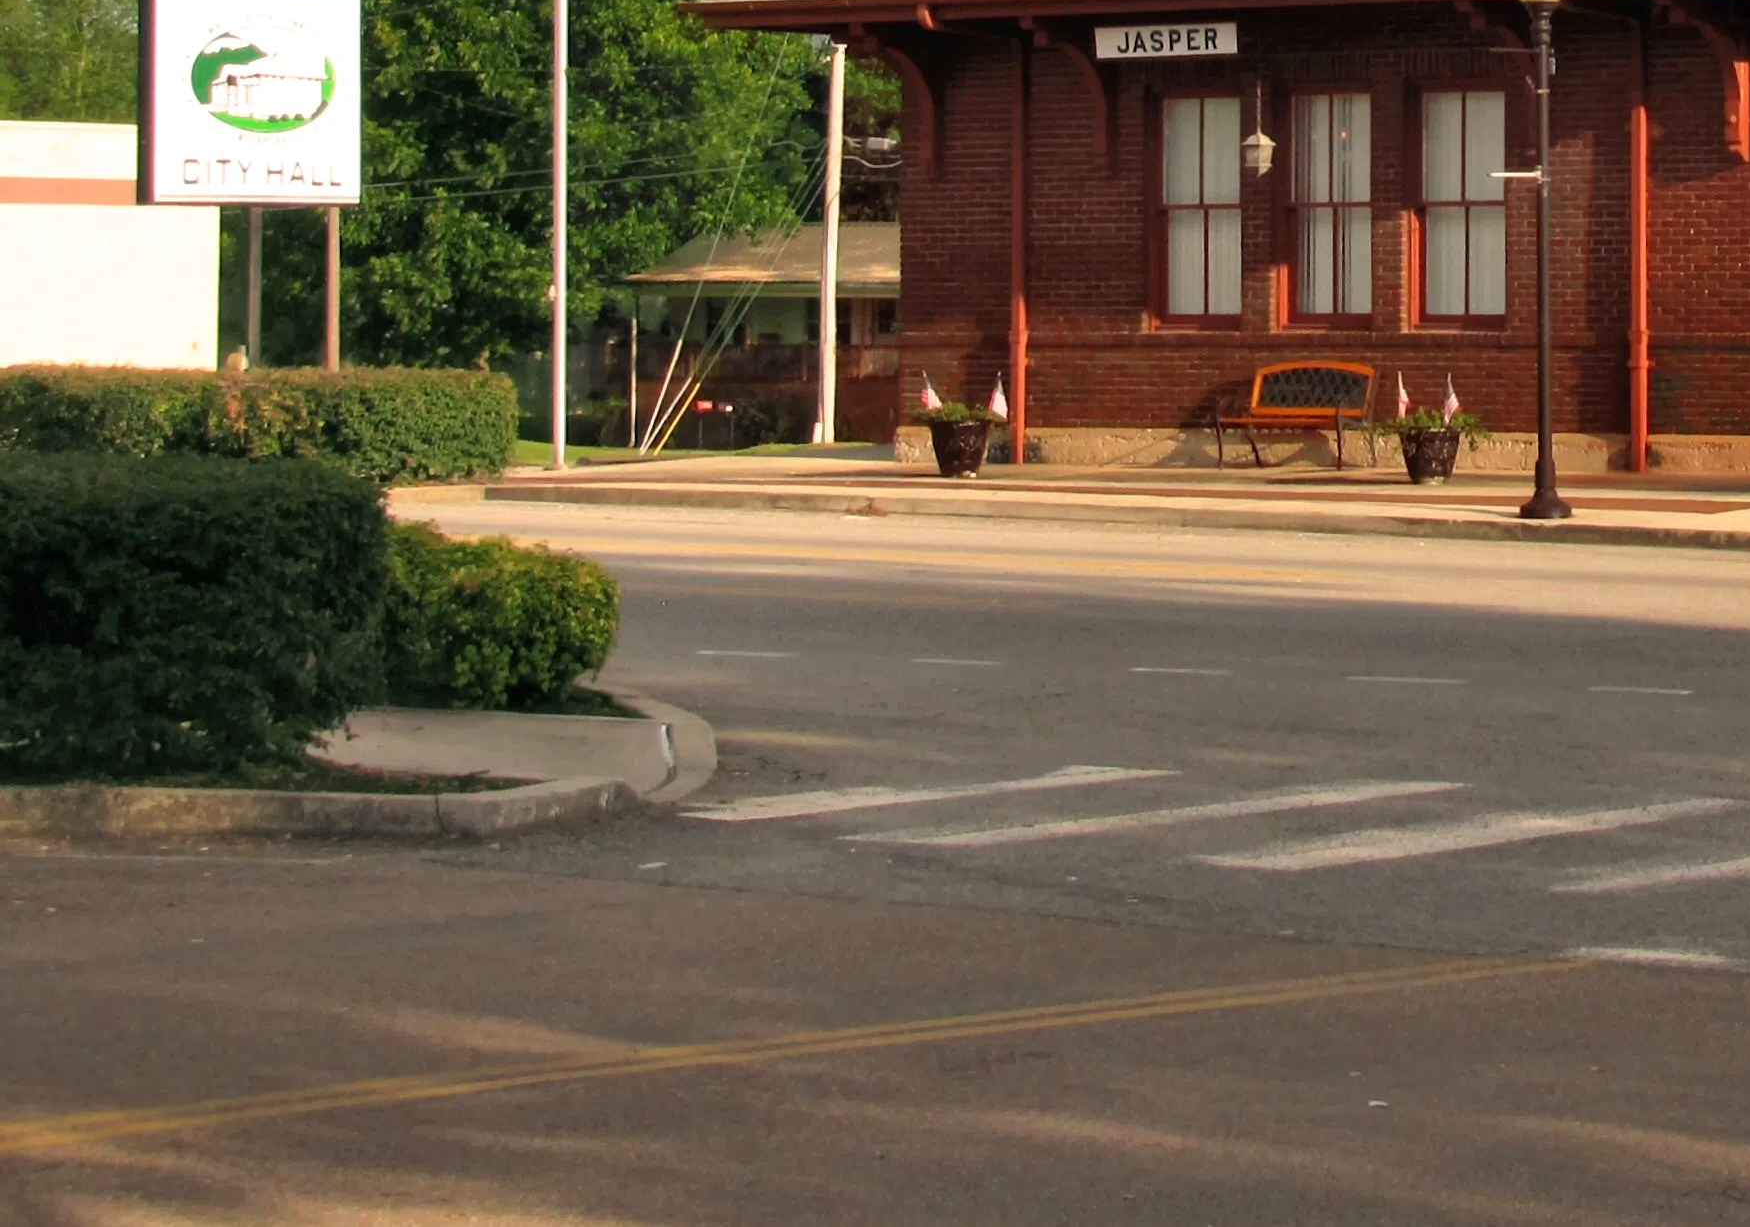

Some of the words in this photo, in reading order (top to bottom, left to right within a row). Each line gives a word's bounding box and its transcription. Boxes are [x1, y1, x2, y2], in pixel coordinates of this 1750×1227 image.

[1117, 28, 1218, 54] JASPER
[183, 159, 252, 185] CITY
[267, 161, 342, 186] HALL
